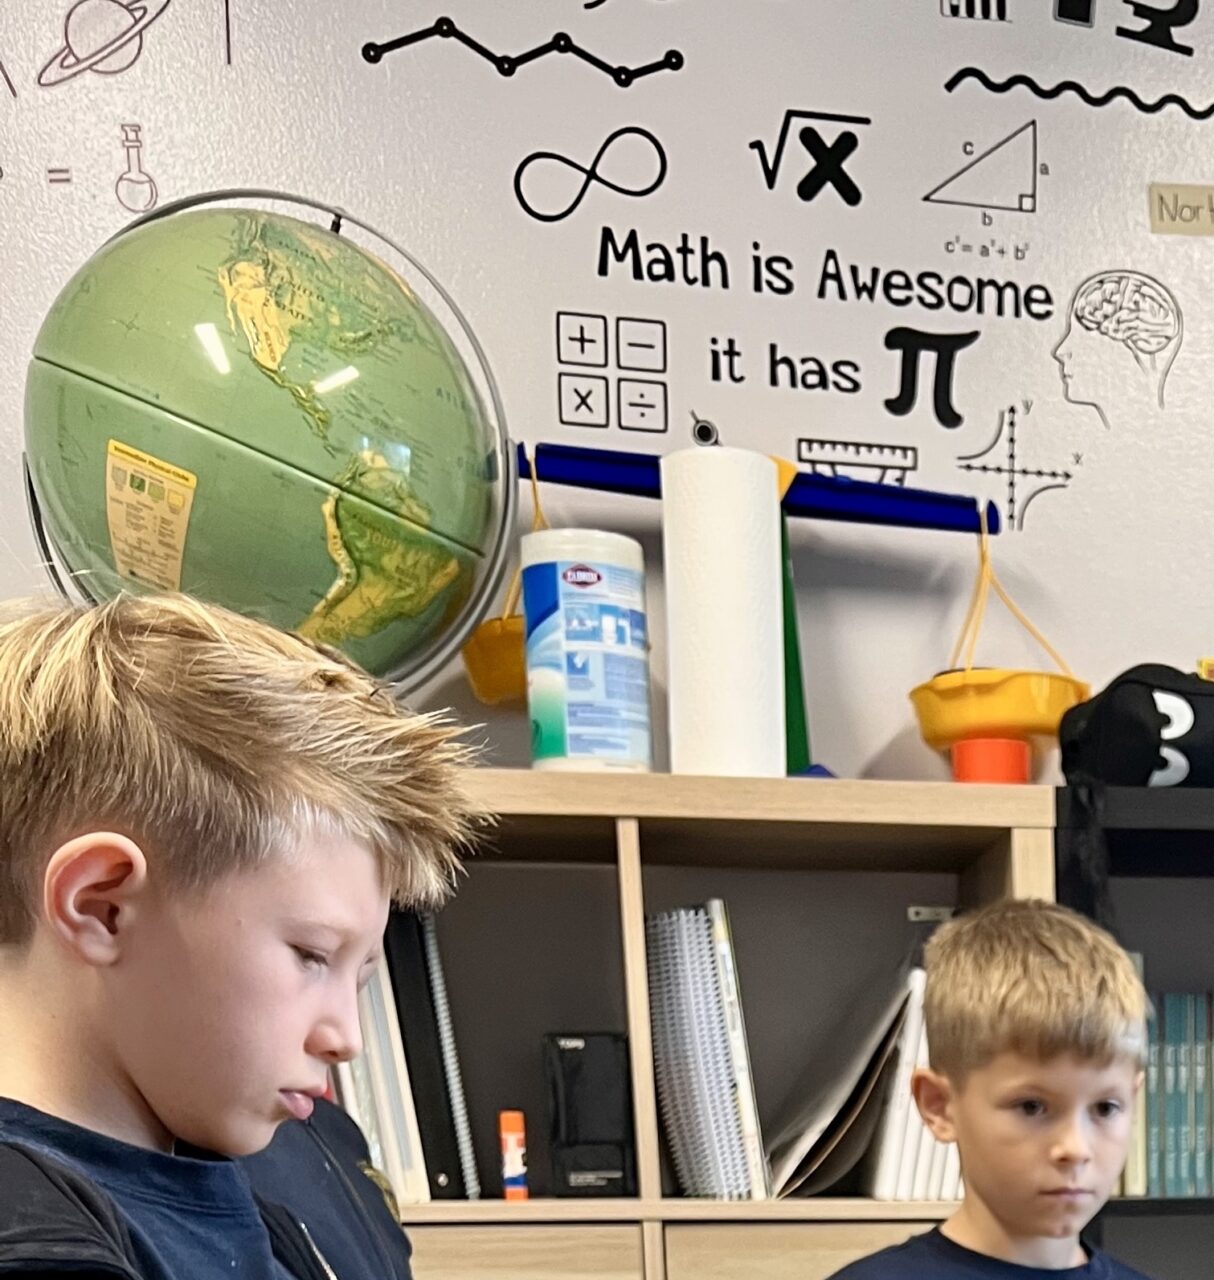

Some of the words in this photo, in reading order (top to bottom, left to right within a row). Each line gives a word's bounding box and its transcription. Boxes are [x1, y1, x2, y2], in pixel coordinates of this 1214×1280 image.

[597, 226, 729, 289] Math
[752, 241, 794, 295] is
[817, 249, 1053, 321] Awesome
[710, 337, 745, 384] it
[769, 343, 861, 393] has
